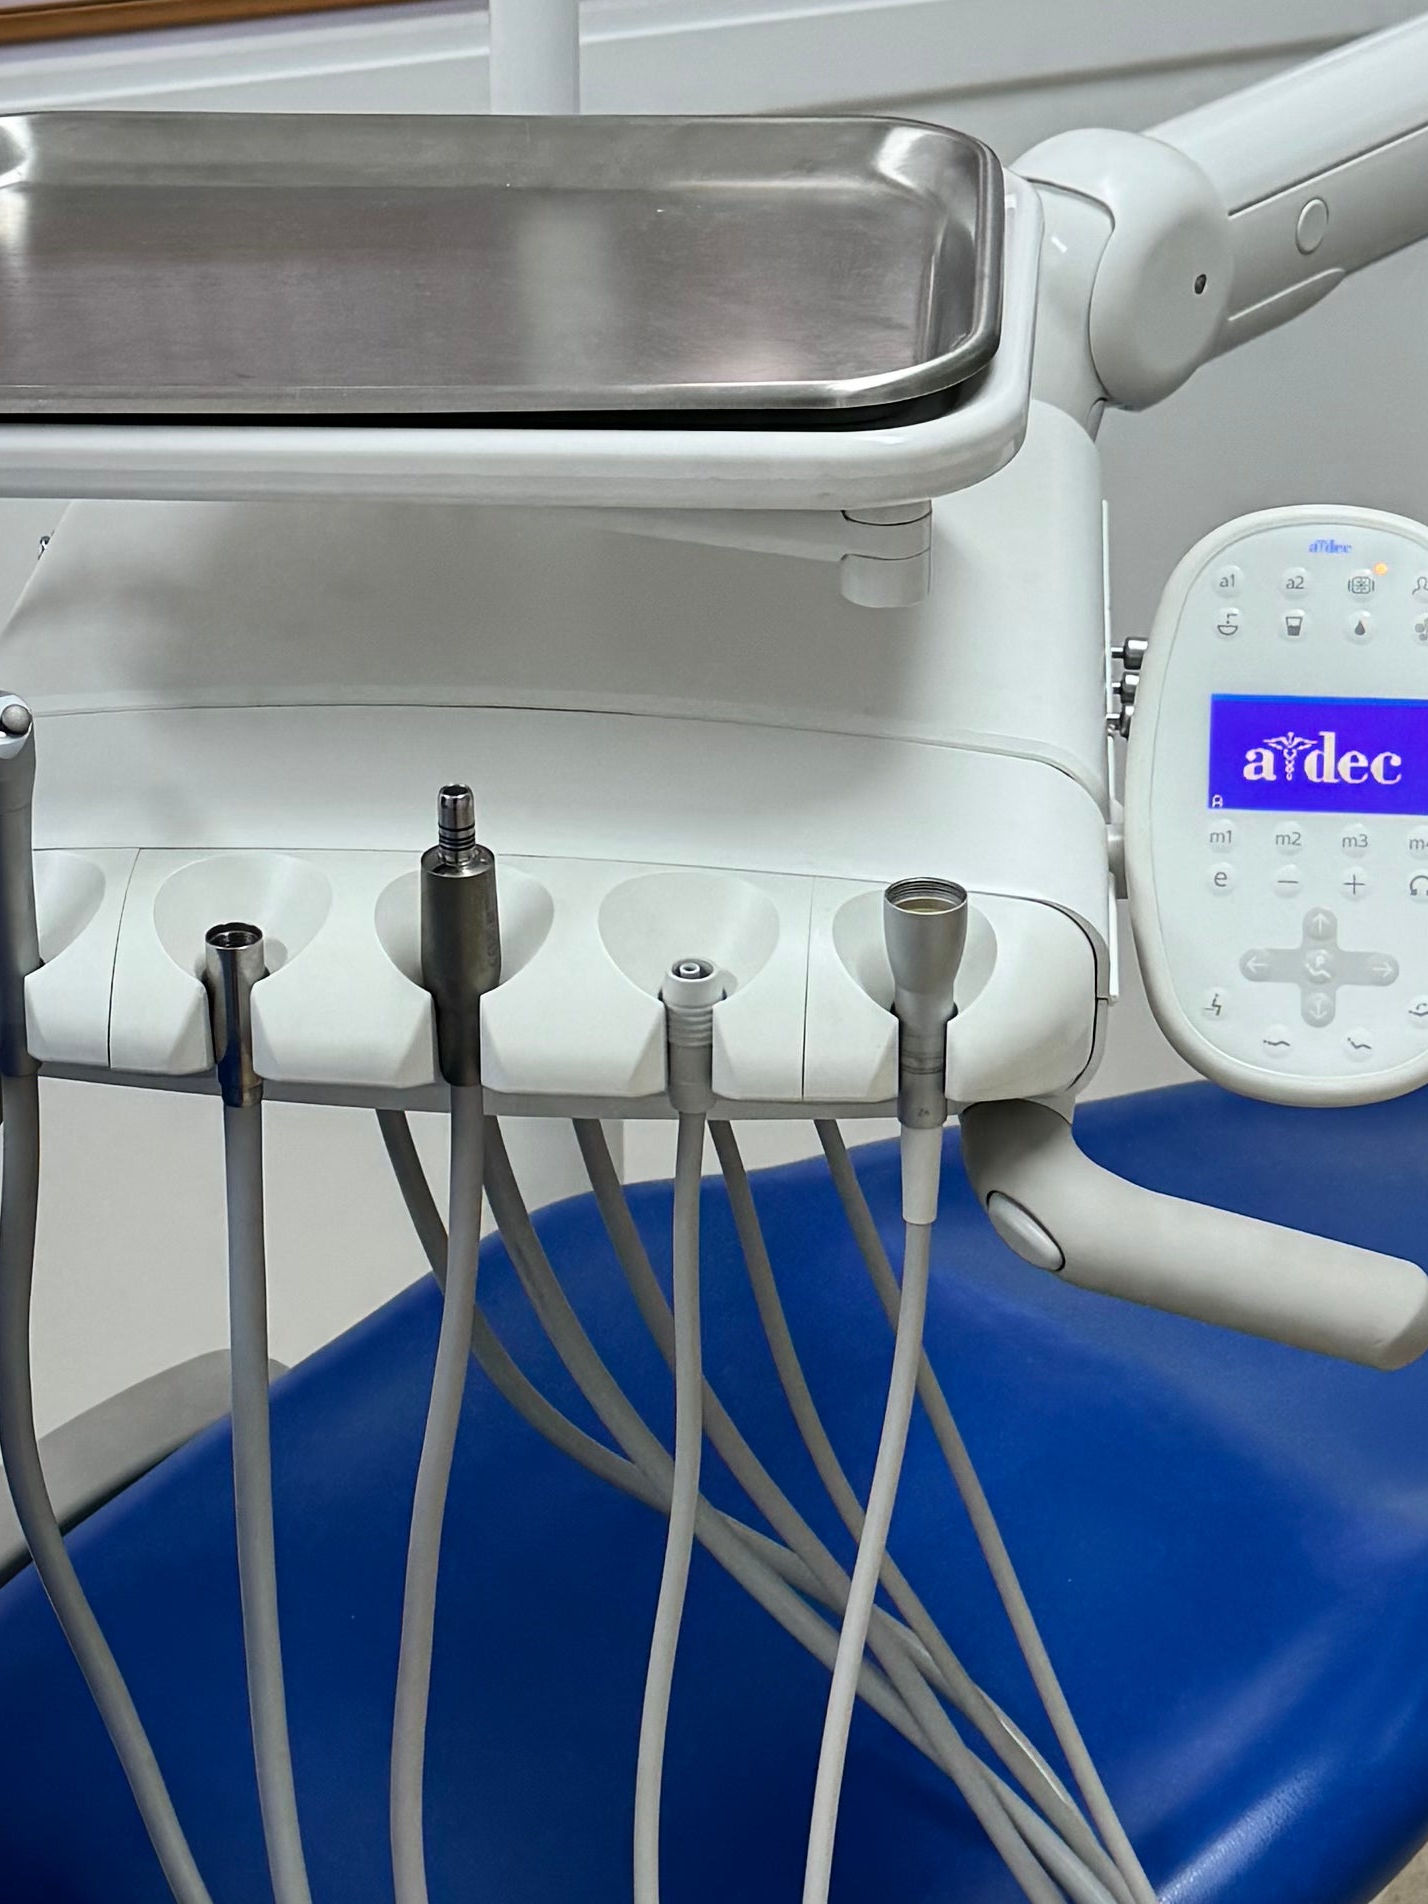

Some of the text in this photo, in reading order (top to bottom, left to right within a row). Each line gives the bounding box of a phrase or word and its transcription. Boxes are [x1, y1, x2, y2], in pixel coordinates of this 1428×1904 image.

[1219, 574, 1236, 588] a1
[1285, 575, 1305, 590] a2
[1209, 829, 1233, 844] m1
[1275, 831, 1302, 847] m2
[1341, 833, 1369, 849] m3
